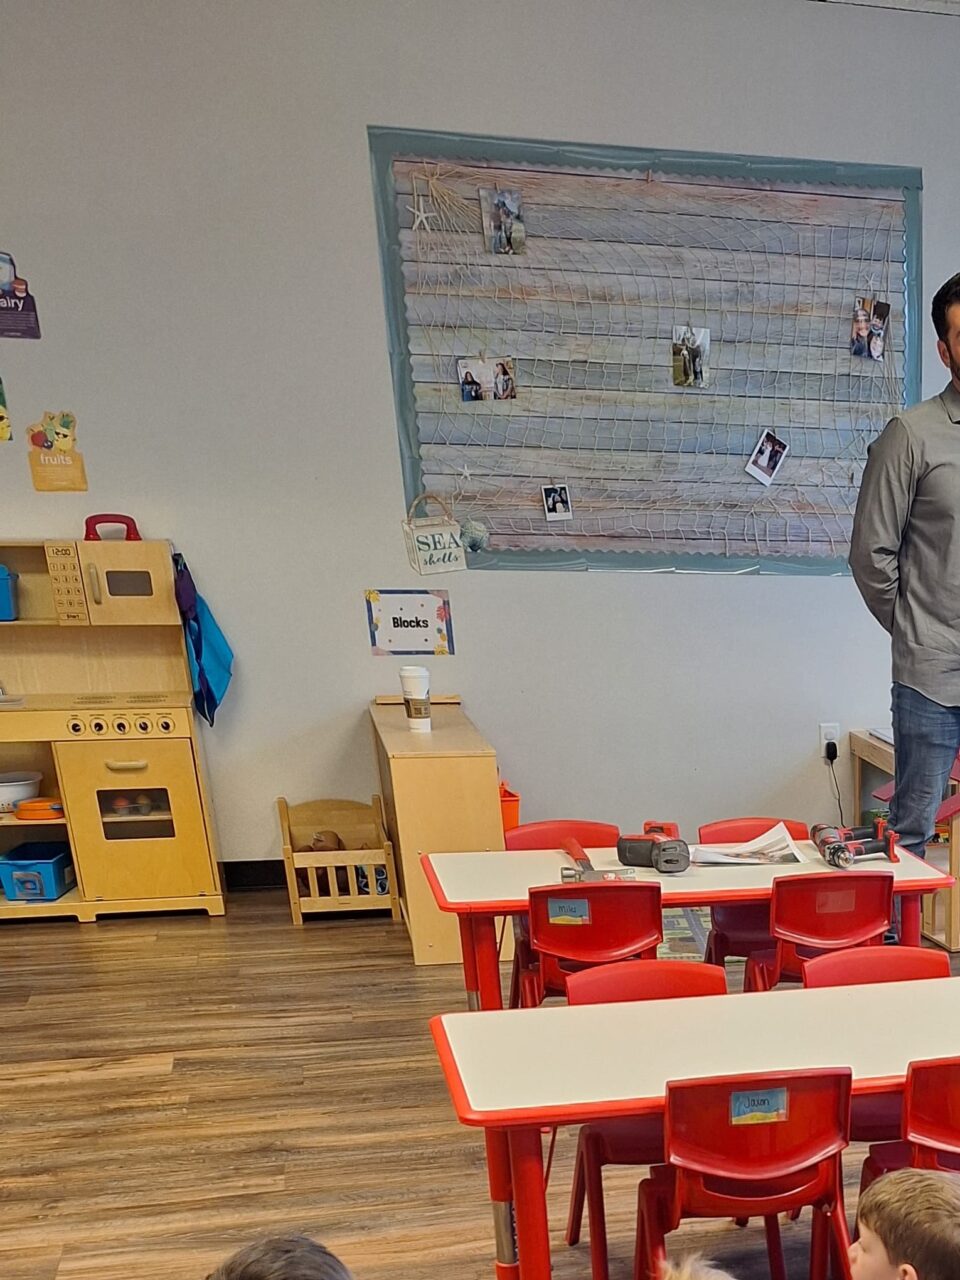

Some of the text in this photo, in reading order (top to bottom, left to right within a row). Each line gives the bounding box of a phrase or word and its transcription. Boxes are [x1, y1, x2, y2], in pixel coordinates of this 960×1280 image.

[0, 296, 24, 312] airy
[39, 452, 73, 466] fruits
[416, 532, 461, 552] SEA
[423, 551, 459, 566] shells
[391, 616, 429, 629] Blocks
